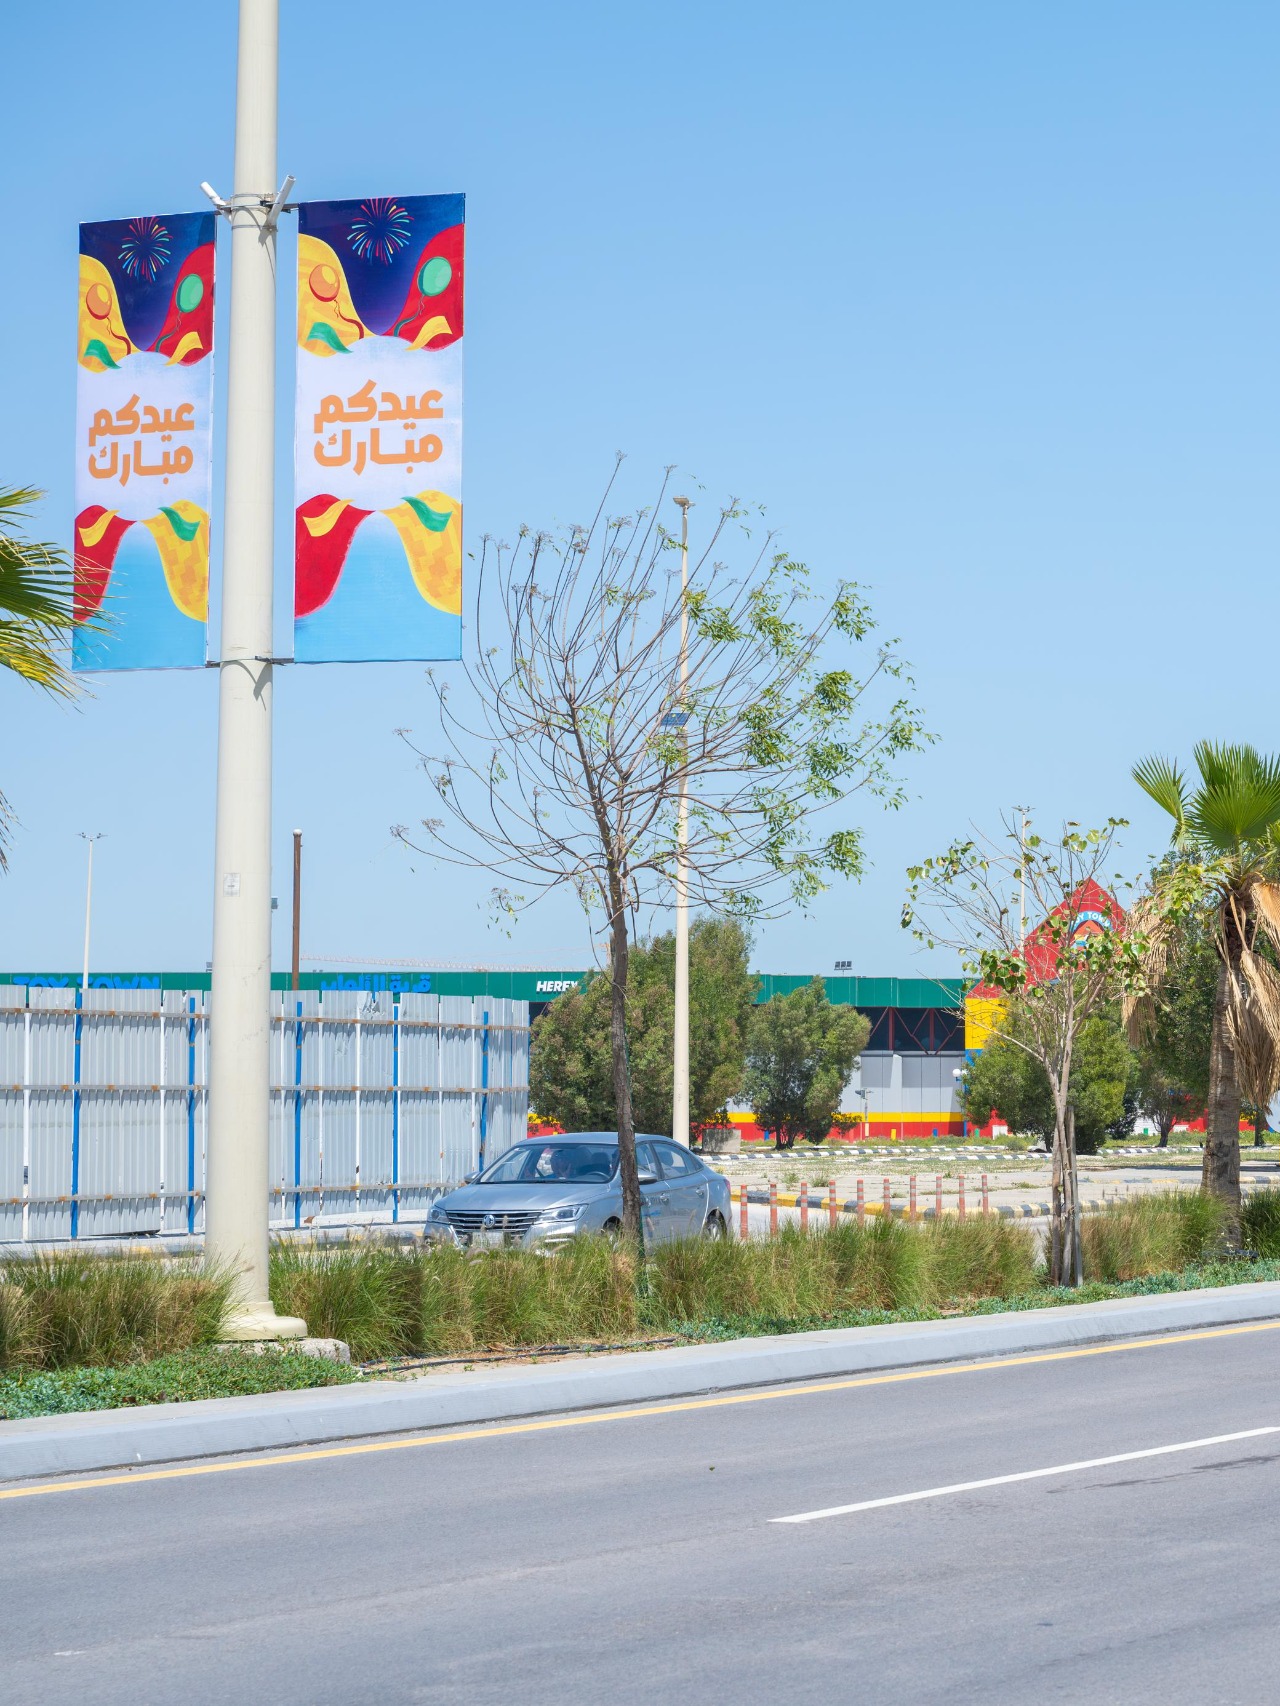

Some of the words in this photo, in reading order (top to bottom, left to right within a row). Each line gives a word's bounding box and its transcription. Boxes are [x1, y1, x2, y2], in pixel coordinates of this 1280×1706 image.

[88, 393, 195, 447] عيدكم
[314, 379, 444, 434] عيدكم
[88, 440, 194, 487] مبارك
[314, 428, 443, 476] مبارك
[536, 980, 579, 992] HERFY
